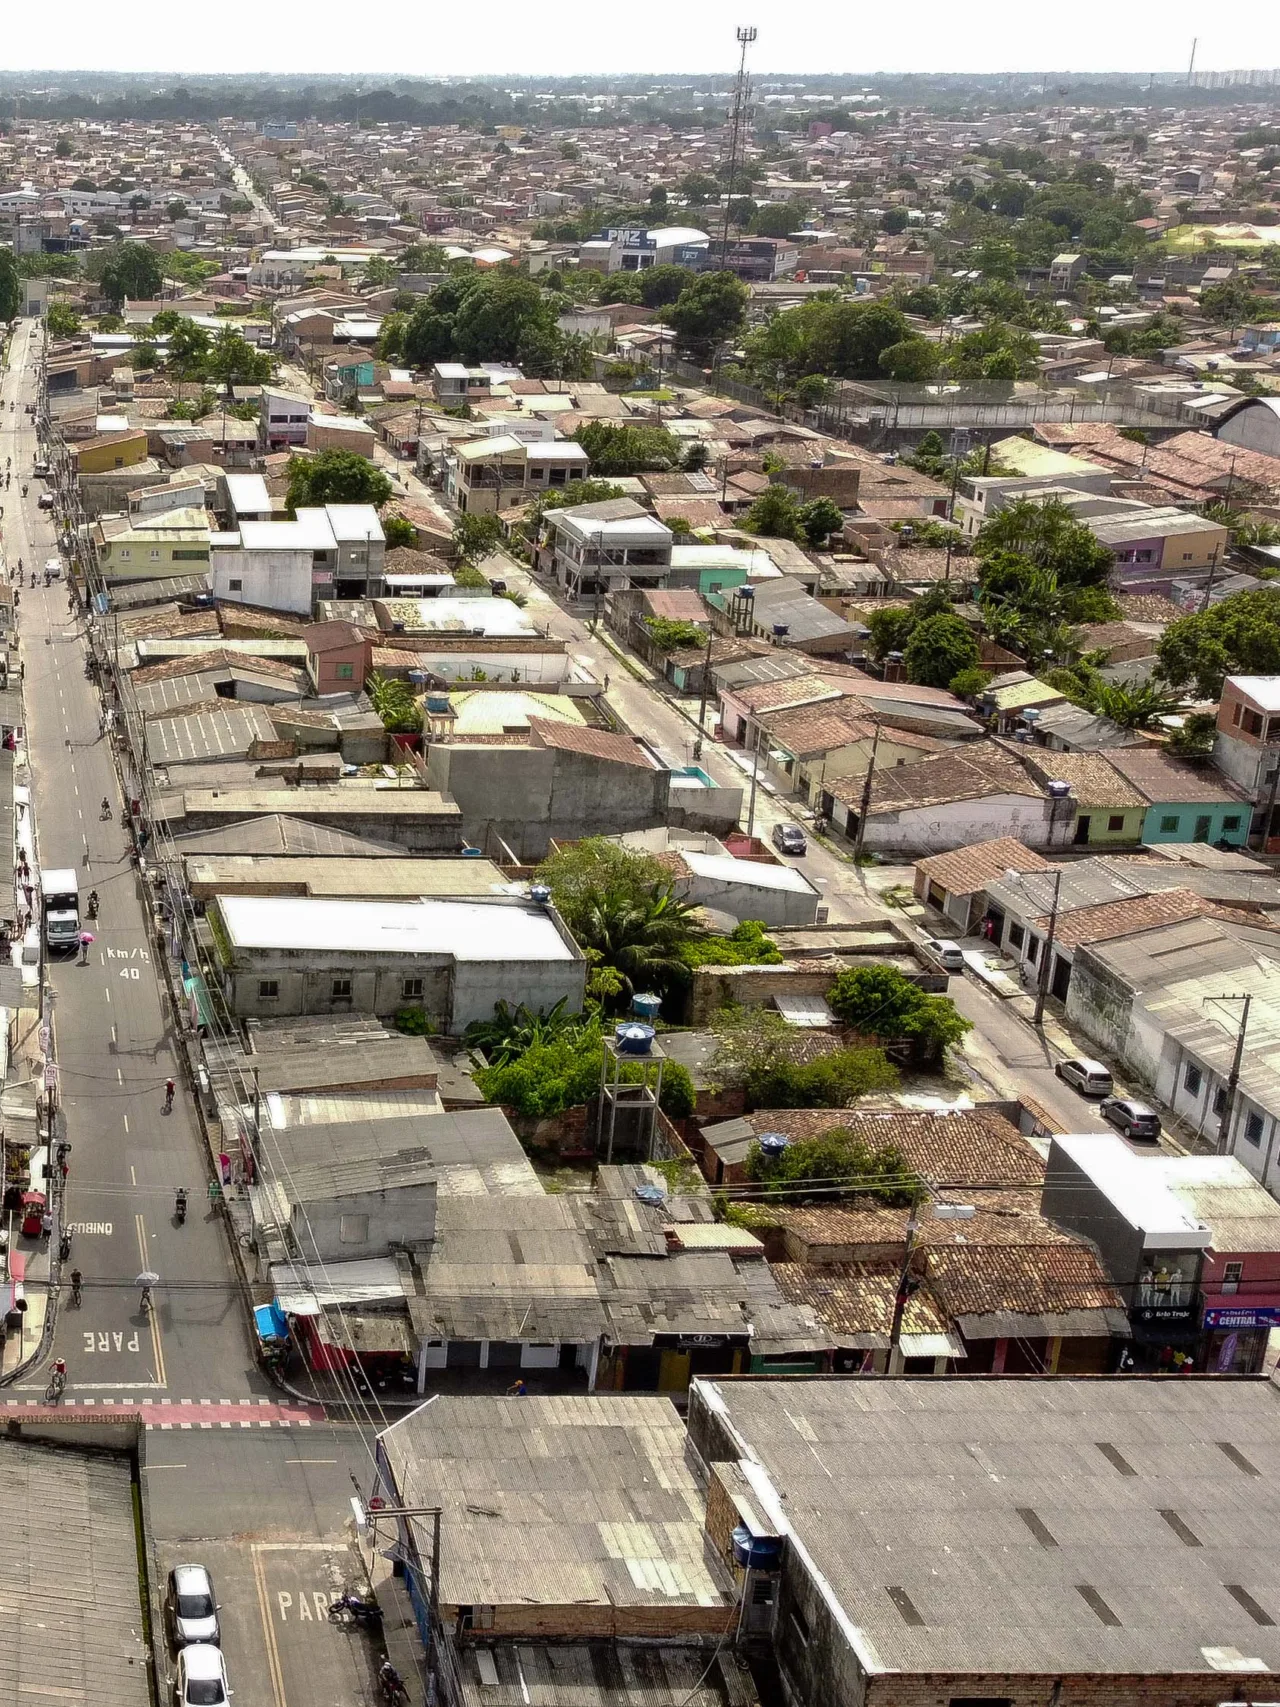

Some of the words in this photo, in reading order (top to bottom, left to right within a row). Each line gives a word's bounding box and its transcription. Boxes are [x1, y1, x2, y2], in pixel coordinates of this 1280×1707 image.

[608, 229, 641, 242] PMZ
[107, 947, 149, 958] km/h
[119, 967, 140, 979] 40
[1219, 1316, 1257, 1325] CENTRAL
[83, 1331, 141, 1352] PARE
